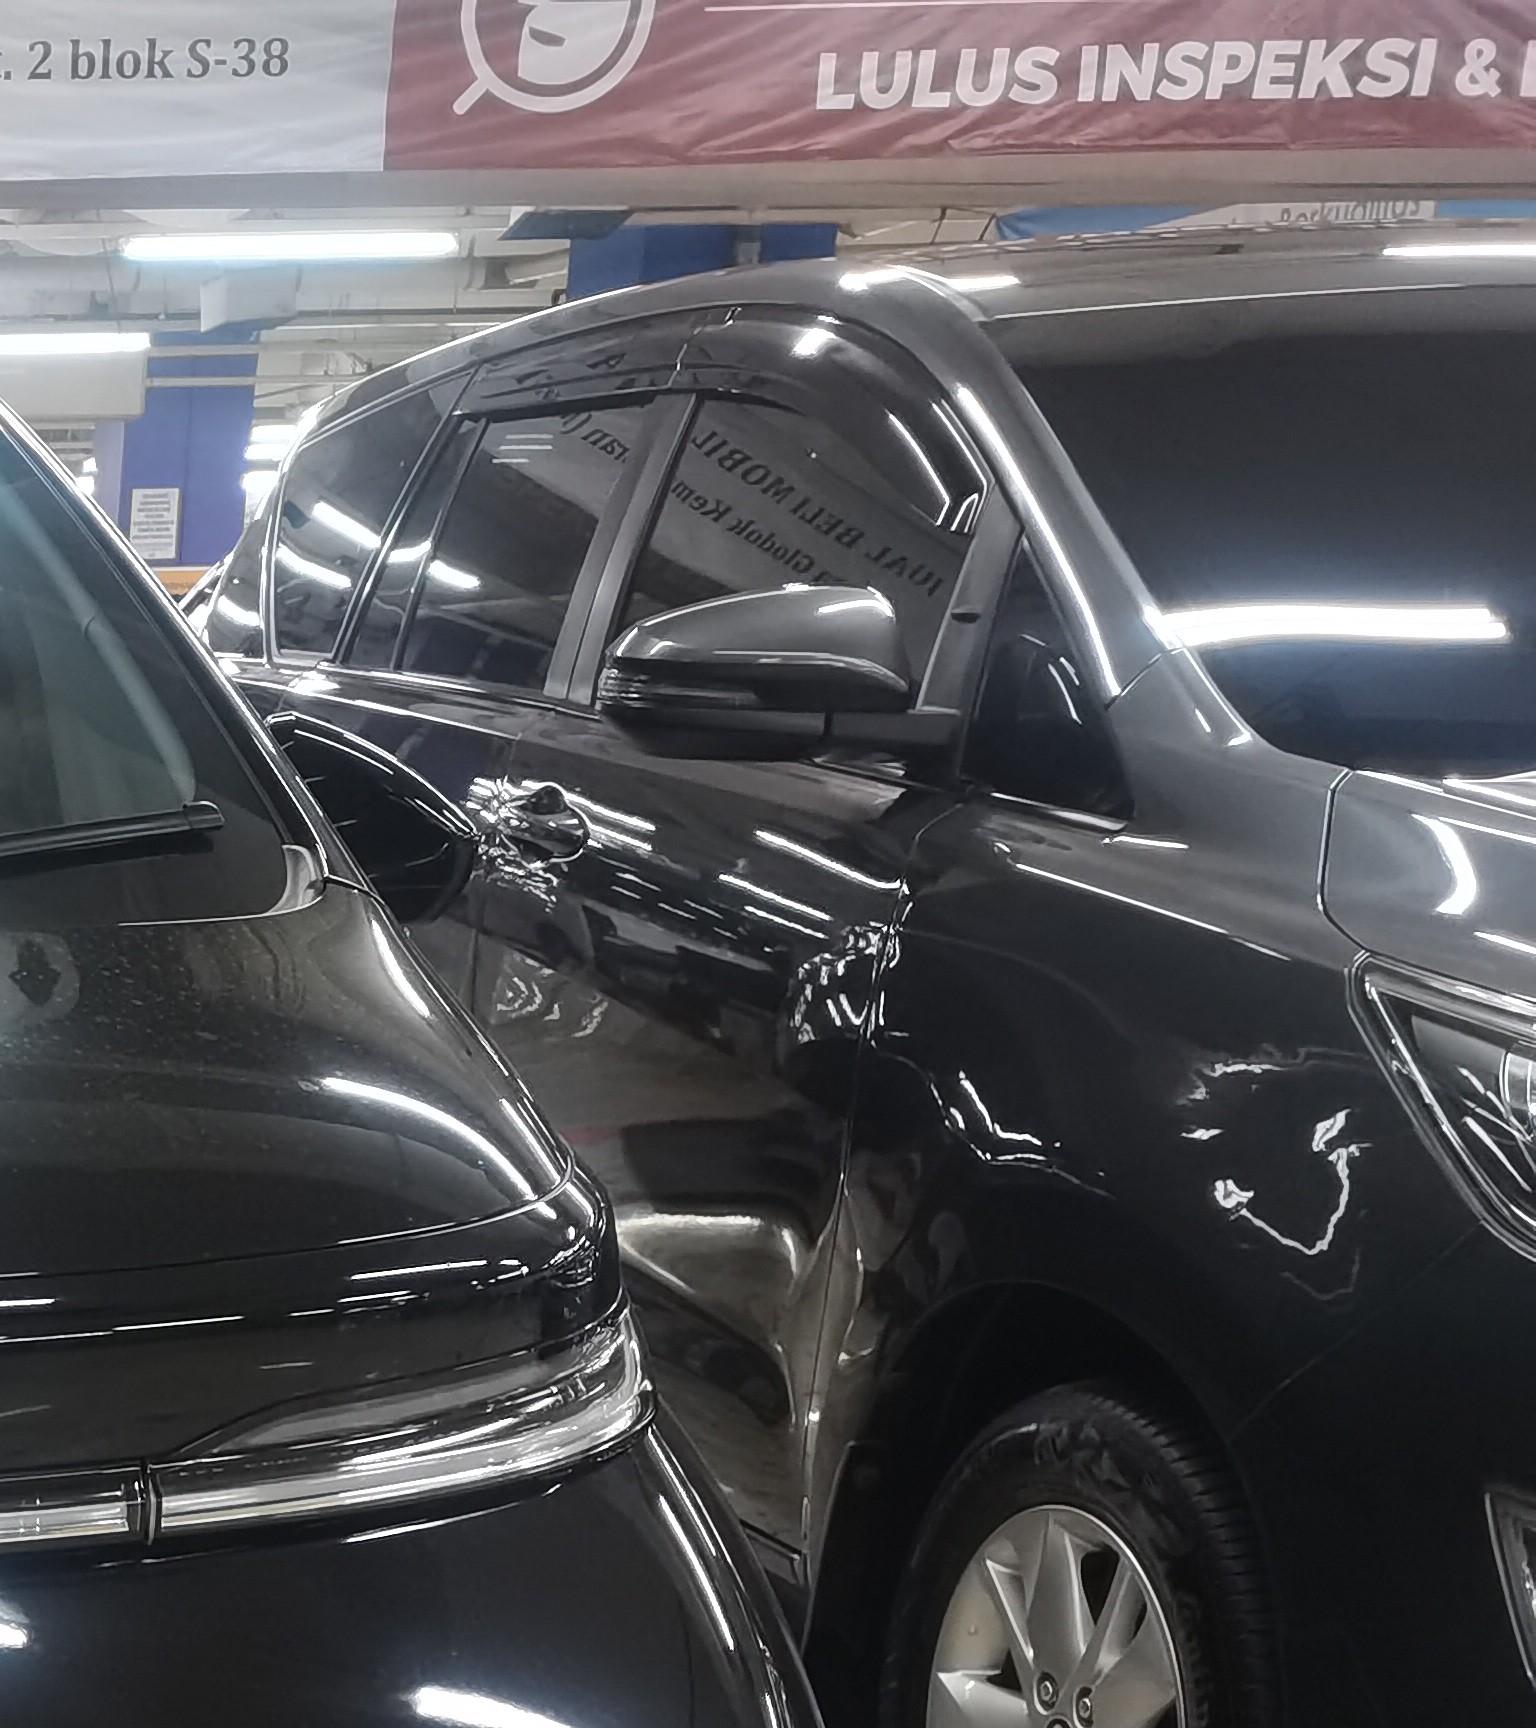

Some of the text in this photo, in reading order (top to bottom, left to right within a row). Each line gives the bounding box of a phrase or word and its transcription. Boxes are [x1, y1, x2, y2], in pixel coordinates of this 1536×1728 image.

[26, 39, 54, 81] 2
[68, 36, 176, 81] blok
[185, 36, 290, 80] S-38
[815, 46, 1060, 110] LULUS
[1077, 37, 1439, 102] INSPEKSI
[1455, 37, 1501, 98] &
